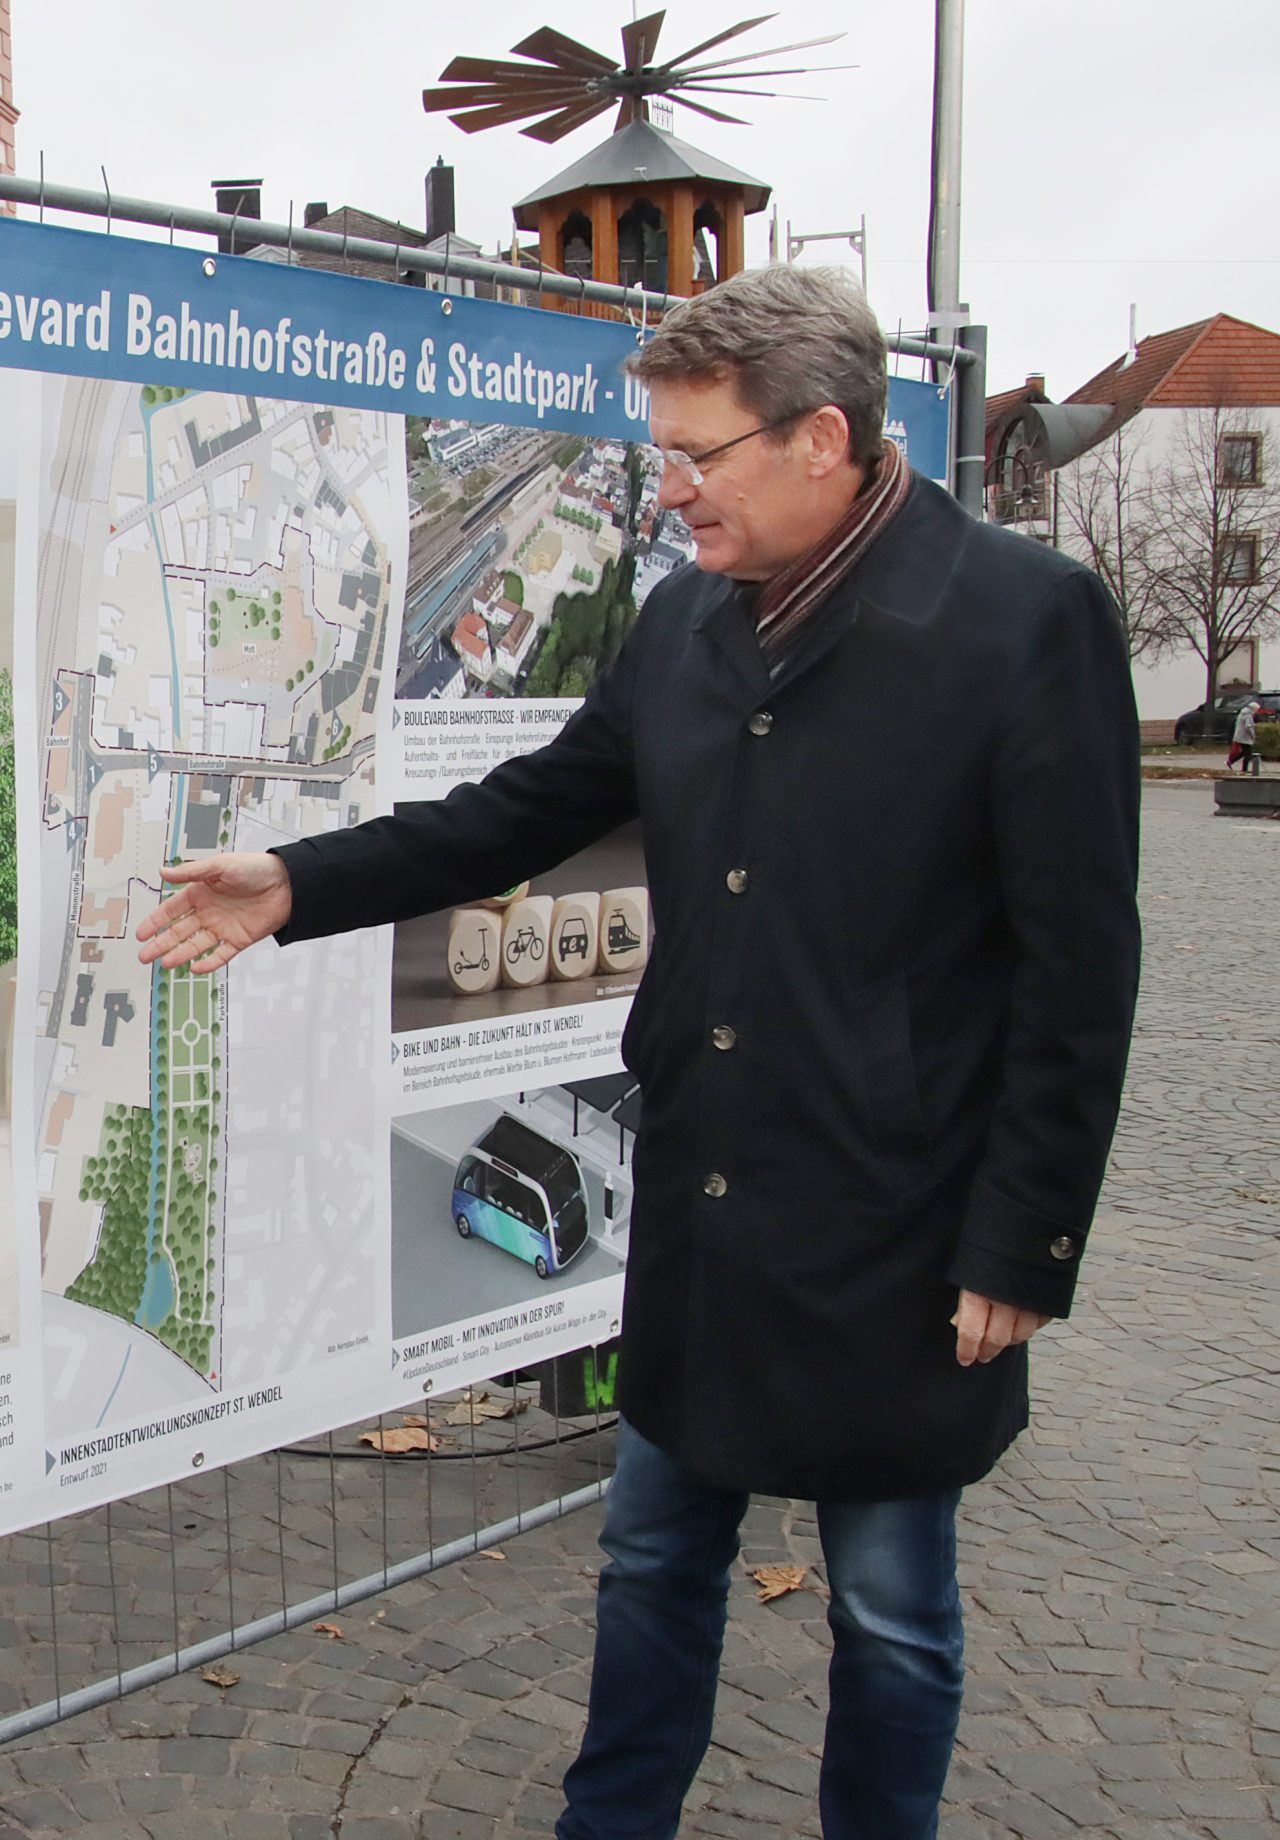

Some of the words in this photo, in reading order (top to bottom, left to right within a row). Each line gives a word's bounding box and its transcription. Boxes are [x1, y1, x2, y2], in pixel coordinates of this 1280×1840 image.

[126, 293, 406, 390] Bahnhofstraße
[416, 338, 436, 394] &
[447, 342, 598, 419] Stadtpark
[55, 692, 63, 711] 3
[404, 710, 448, 726] BOULEVARD
[449, 709, 515, 725] BAHNHOFSTRASSE
[520, 709, 534, 724] WIR
[332, 719, 339, 735] 6
[150, 754, 157, 772] 5
[189, 759, 225, 769] Bahnhofstraße
[89, 765, 95, 783] 1
[68, 826, 76, 840] 4
[403, 1041, 421, 1058] BIKE
[422, 1038, 439, 1055] UND
[440, 1035, 461, 1052] BAHN
[468, 1031, 481, 1047] DIE
[481, 1025, 515, 1045] ZUKUNFT
[515, 1022, 533, 1039] HÄLT
[533, 1021, 541, 1035] IN
[553, 1015, 584, 1032] WENDEL!
[403, 1341, 430, 1362] SMART
[431, 1334, 455, 1353] MOBIL
[462, 1327, 477, 1344] MIT
[477, 1315, 519, 1339] INNOVATION
[520, 1312, 528, 1326] IN
[529, 1307, 543, 1324] DER
[544, 1301, 565, 1319] SPUR!
[60, 1400, 232, 1466] INNENSTADTENTWICKLUNGSKONZEPT
[247, 1385, 283, 1409] WENDEL
[59, 1467, 89, 1487] Entwurf
[90, 1461, 108, 1478] 2021
